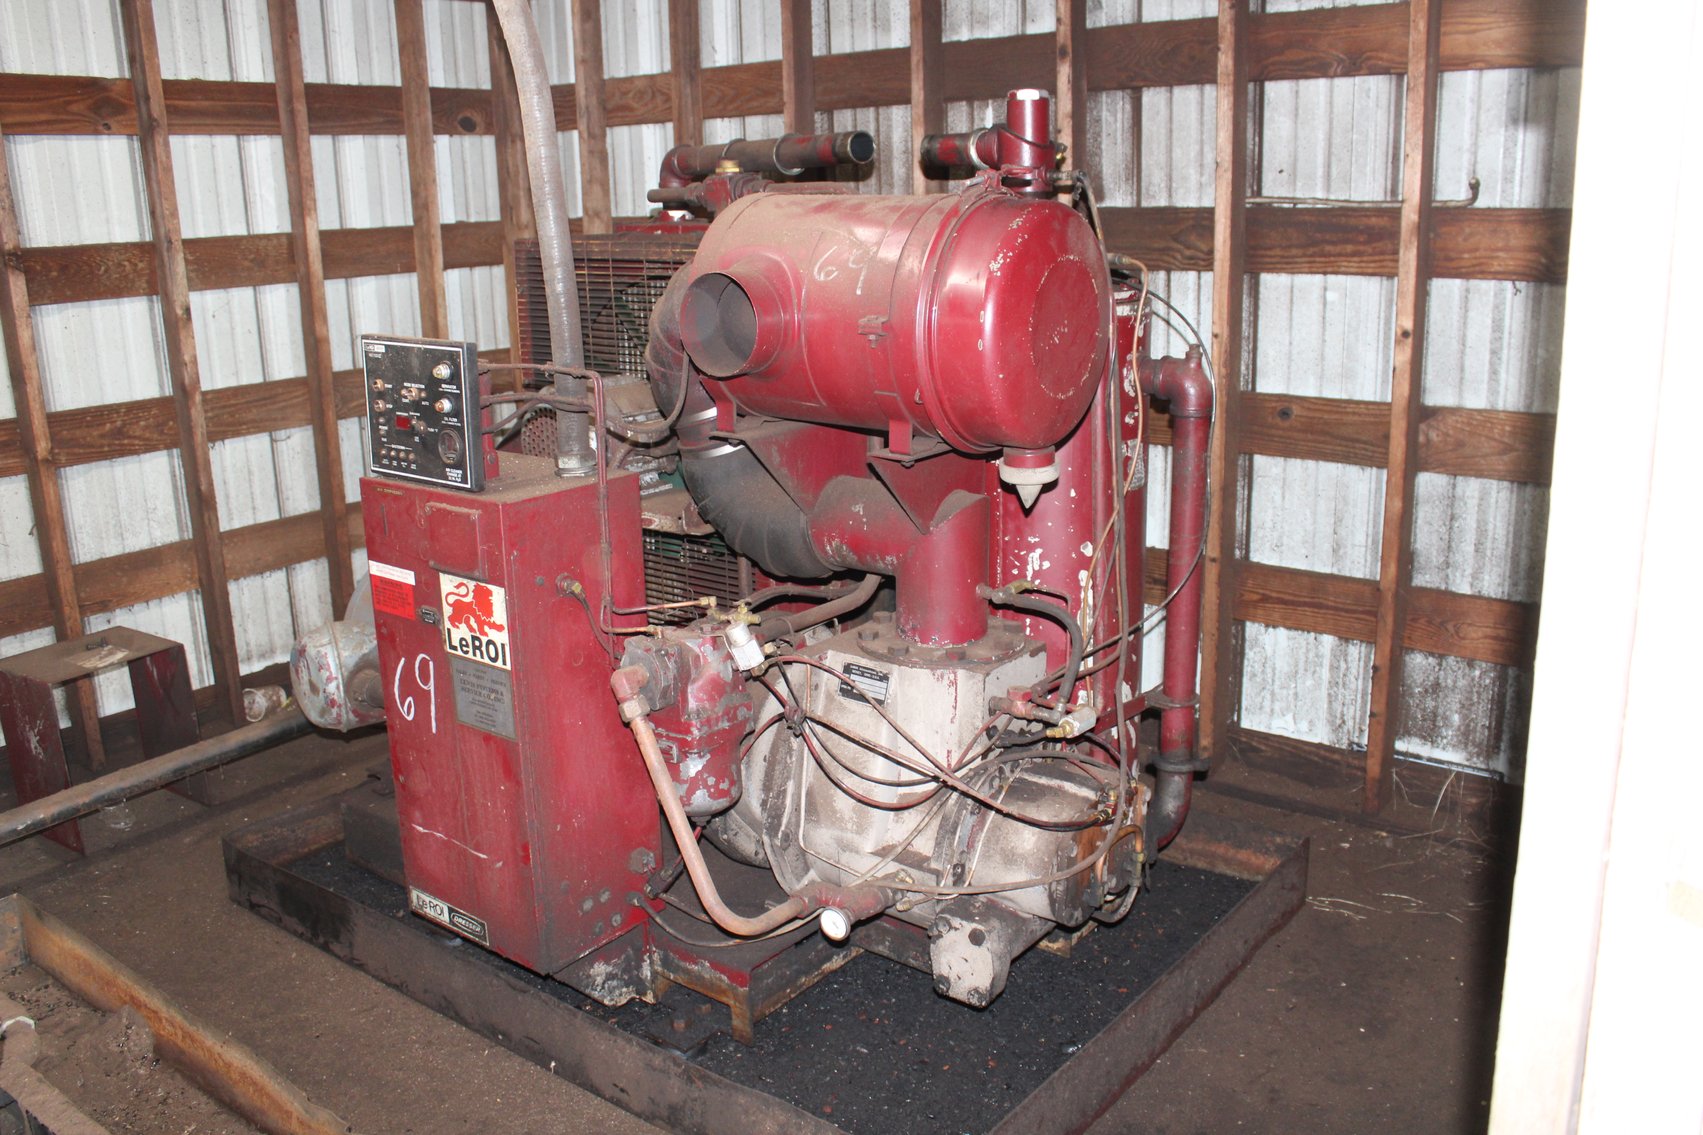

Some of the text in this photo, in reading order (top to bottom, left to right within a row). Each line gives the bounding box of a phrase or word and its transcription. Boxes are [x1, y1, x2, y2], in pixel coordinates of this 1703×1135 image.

[813, 245, 869, 296] 69
[447, 627, 508, 667] LeROI
[394, 652, 437, 735] 69
[454, 915, 481, 933] DRESSER
